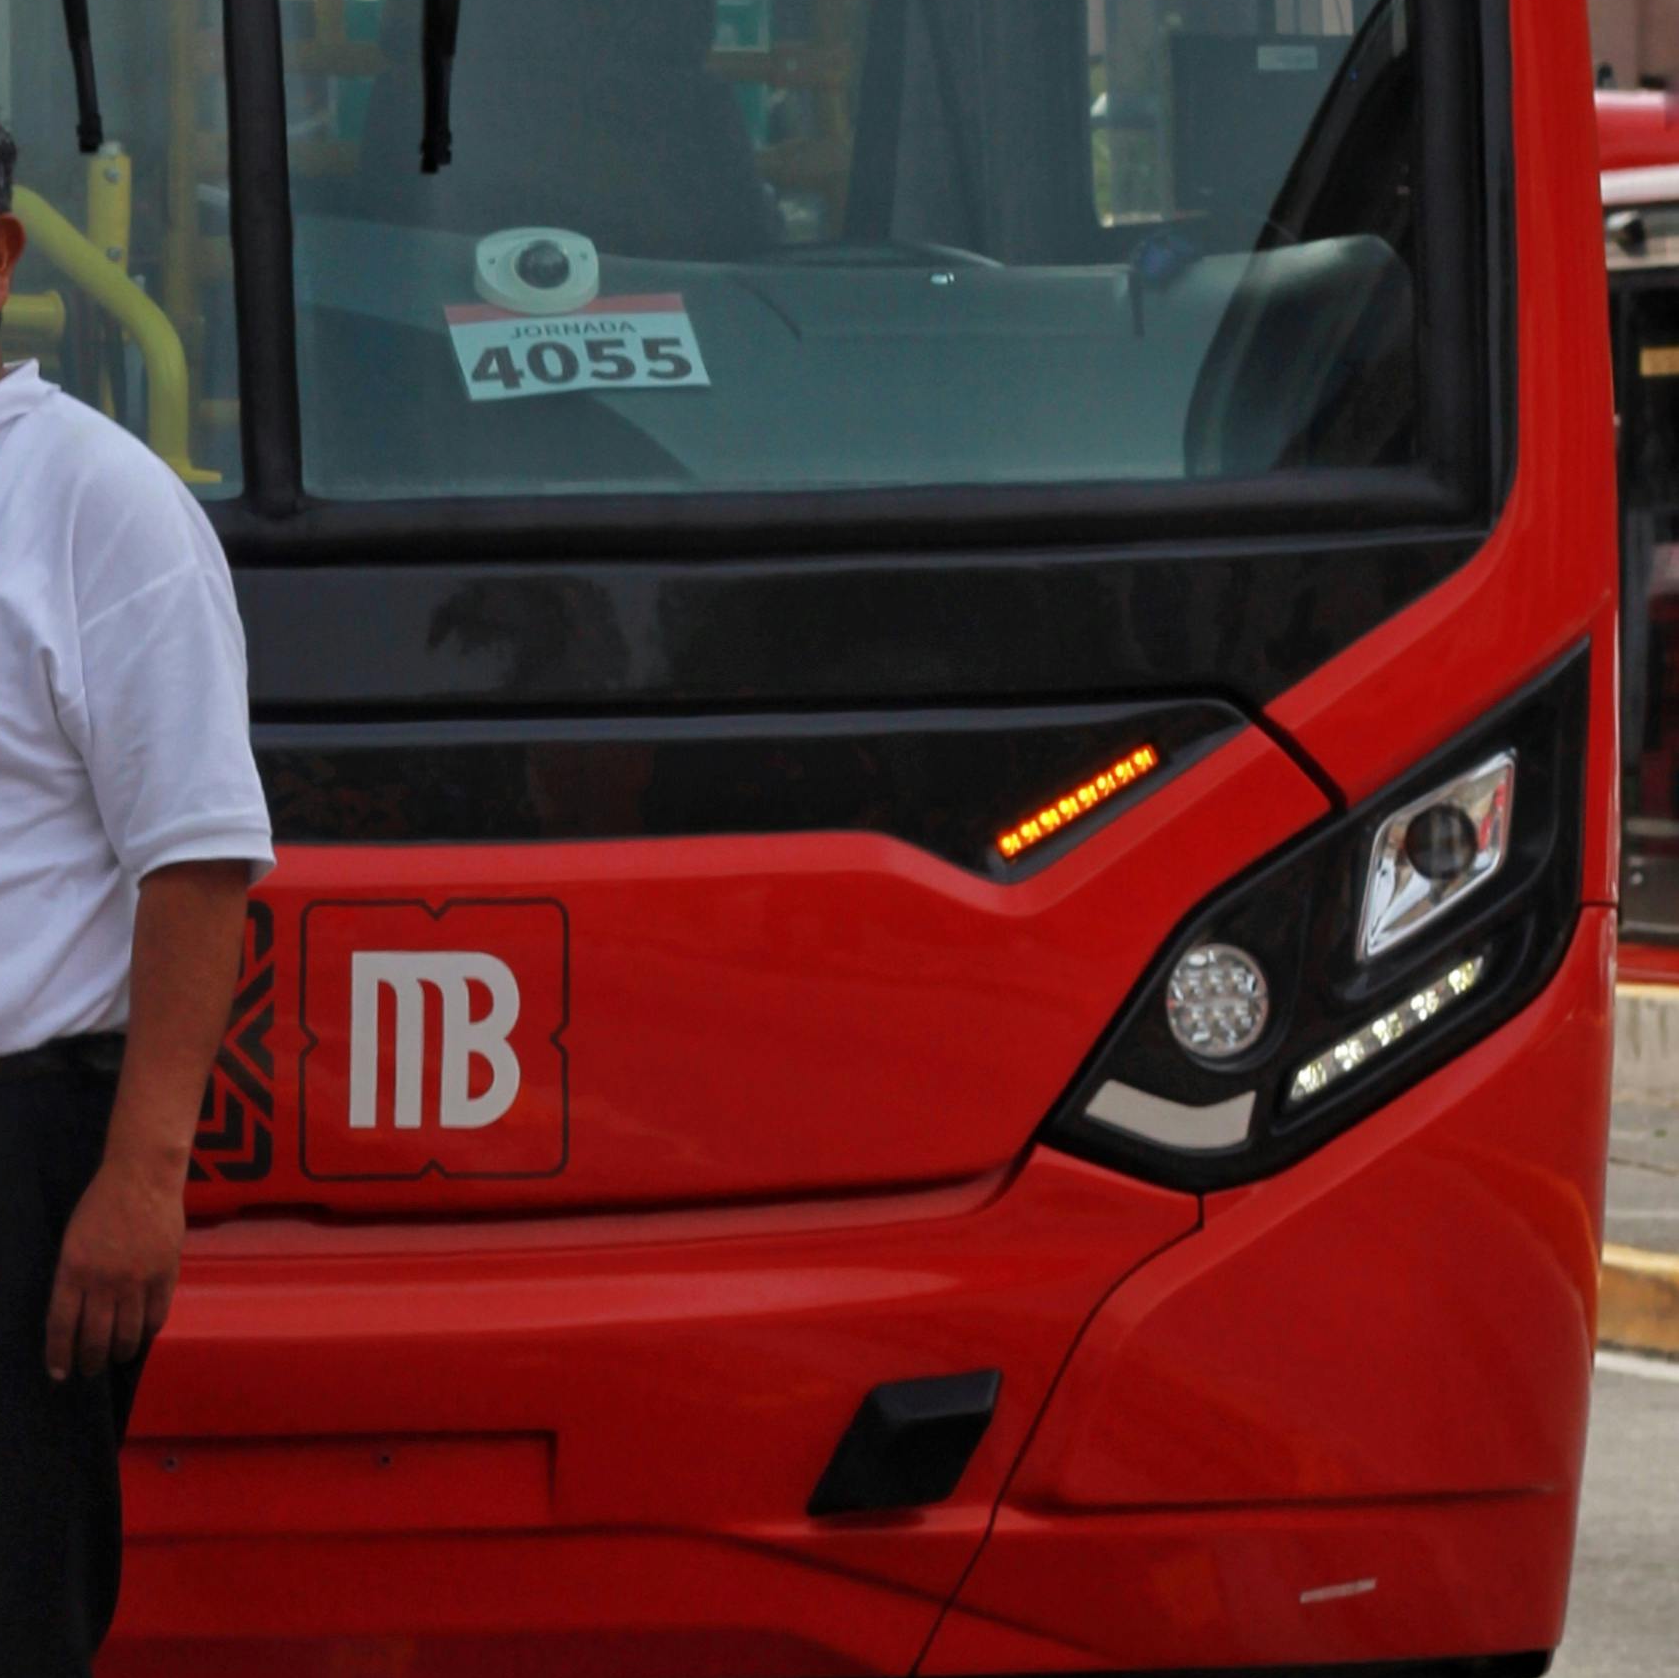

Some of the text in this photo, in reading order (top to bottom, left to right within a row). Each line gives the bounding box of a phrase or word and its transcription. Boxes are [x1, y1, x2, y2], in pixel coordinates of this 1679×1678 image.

[510, 320, 636, 339] JORNADA
[471, 336, 692, 391] 4055
[349, 950, 521, 1130] MB
